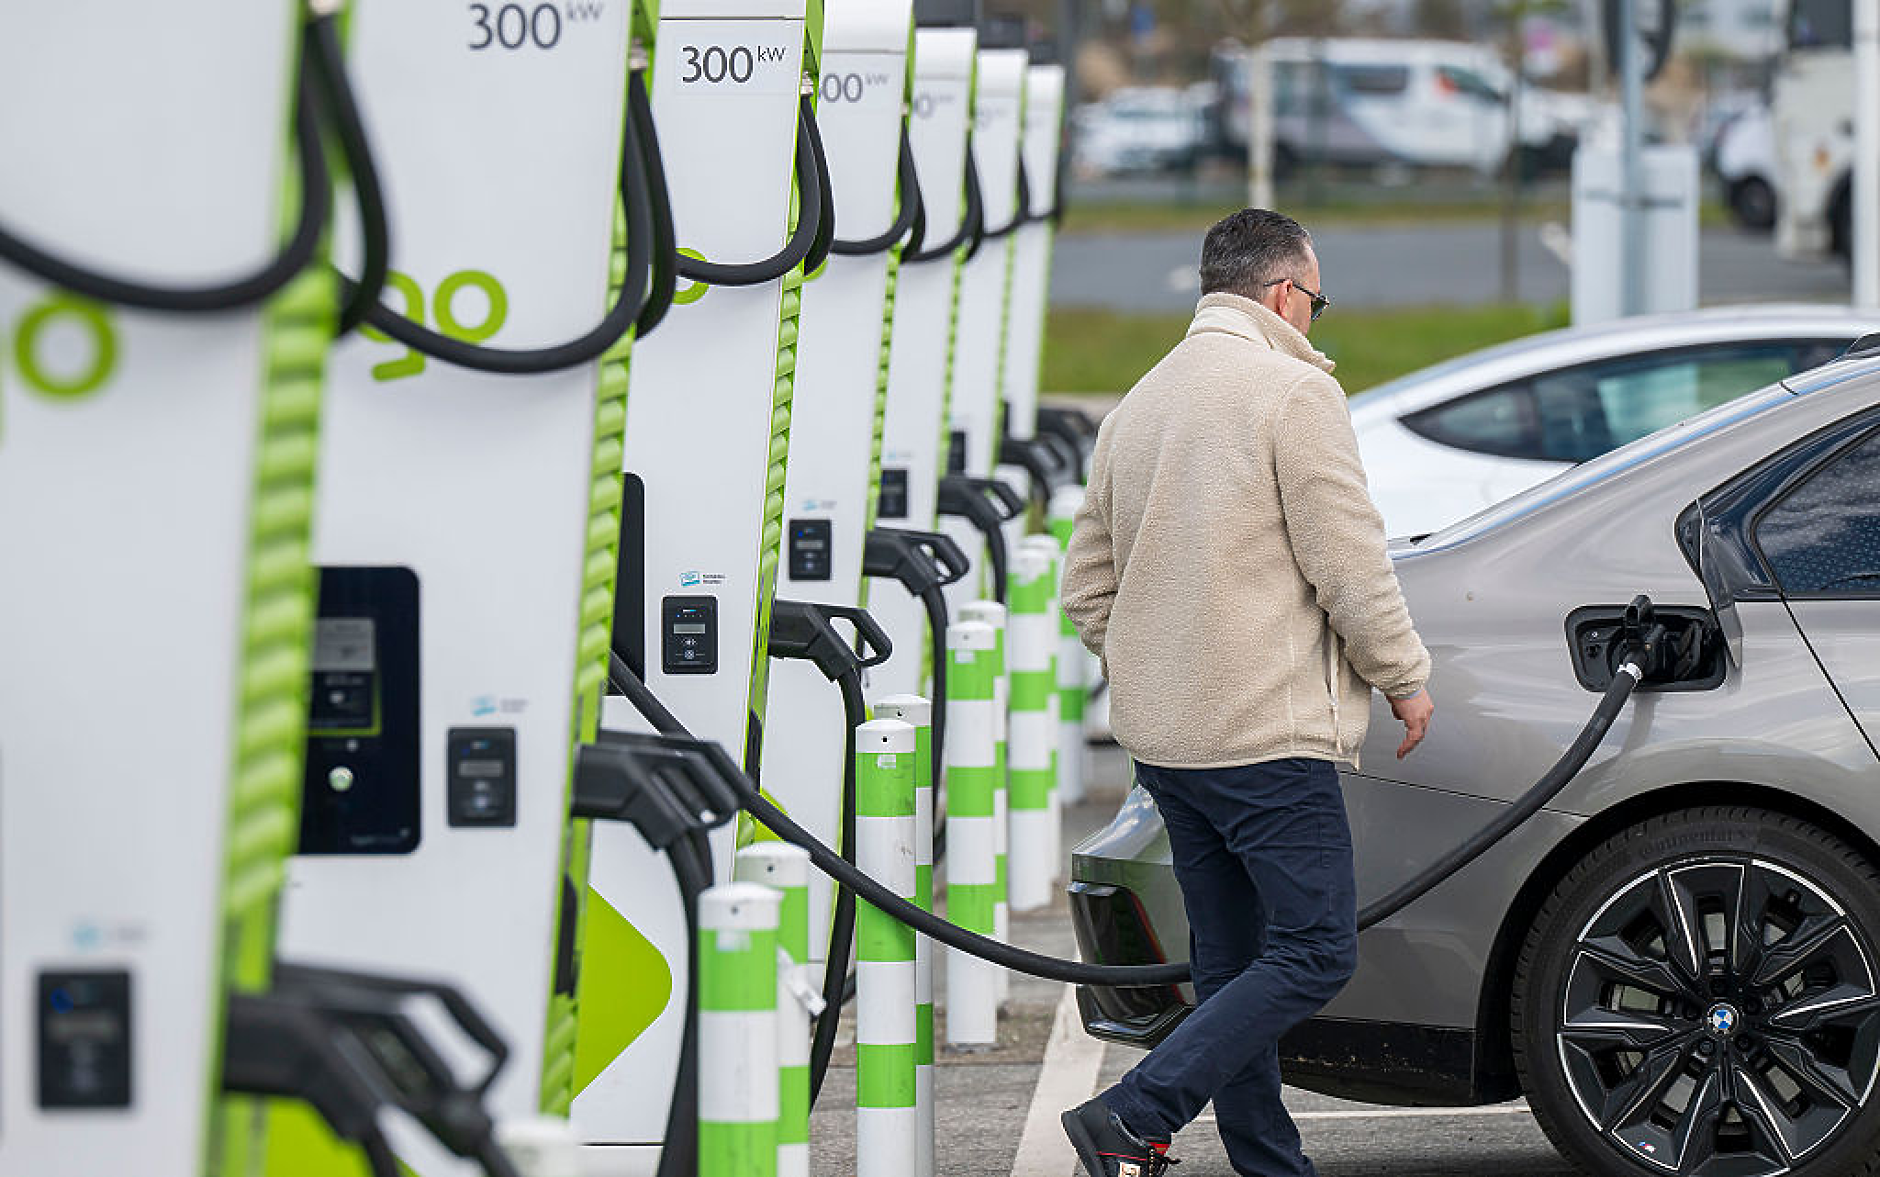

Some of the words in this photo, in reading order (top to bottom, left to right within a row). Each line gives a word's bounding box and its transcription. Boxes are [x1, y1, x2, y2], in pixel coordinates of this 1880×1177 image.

[469, 3, 561, 50] 300
[568, 0, 605, 20] kW
[682, 46, 754, 83] 300
[757, 45, 787, 61] kW
[820, 72, 863, 103] 00
